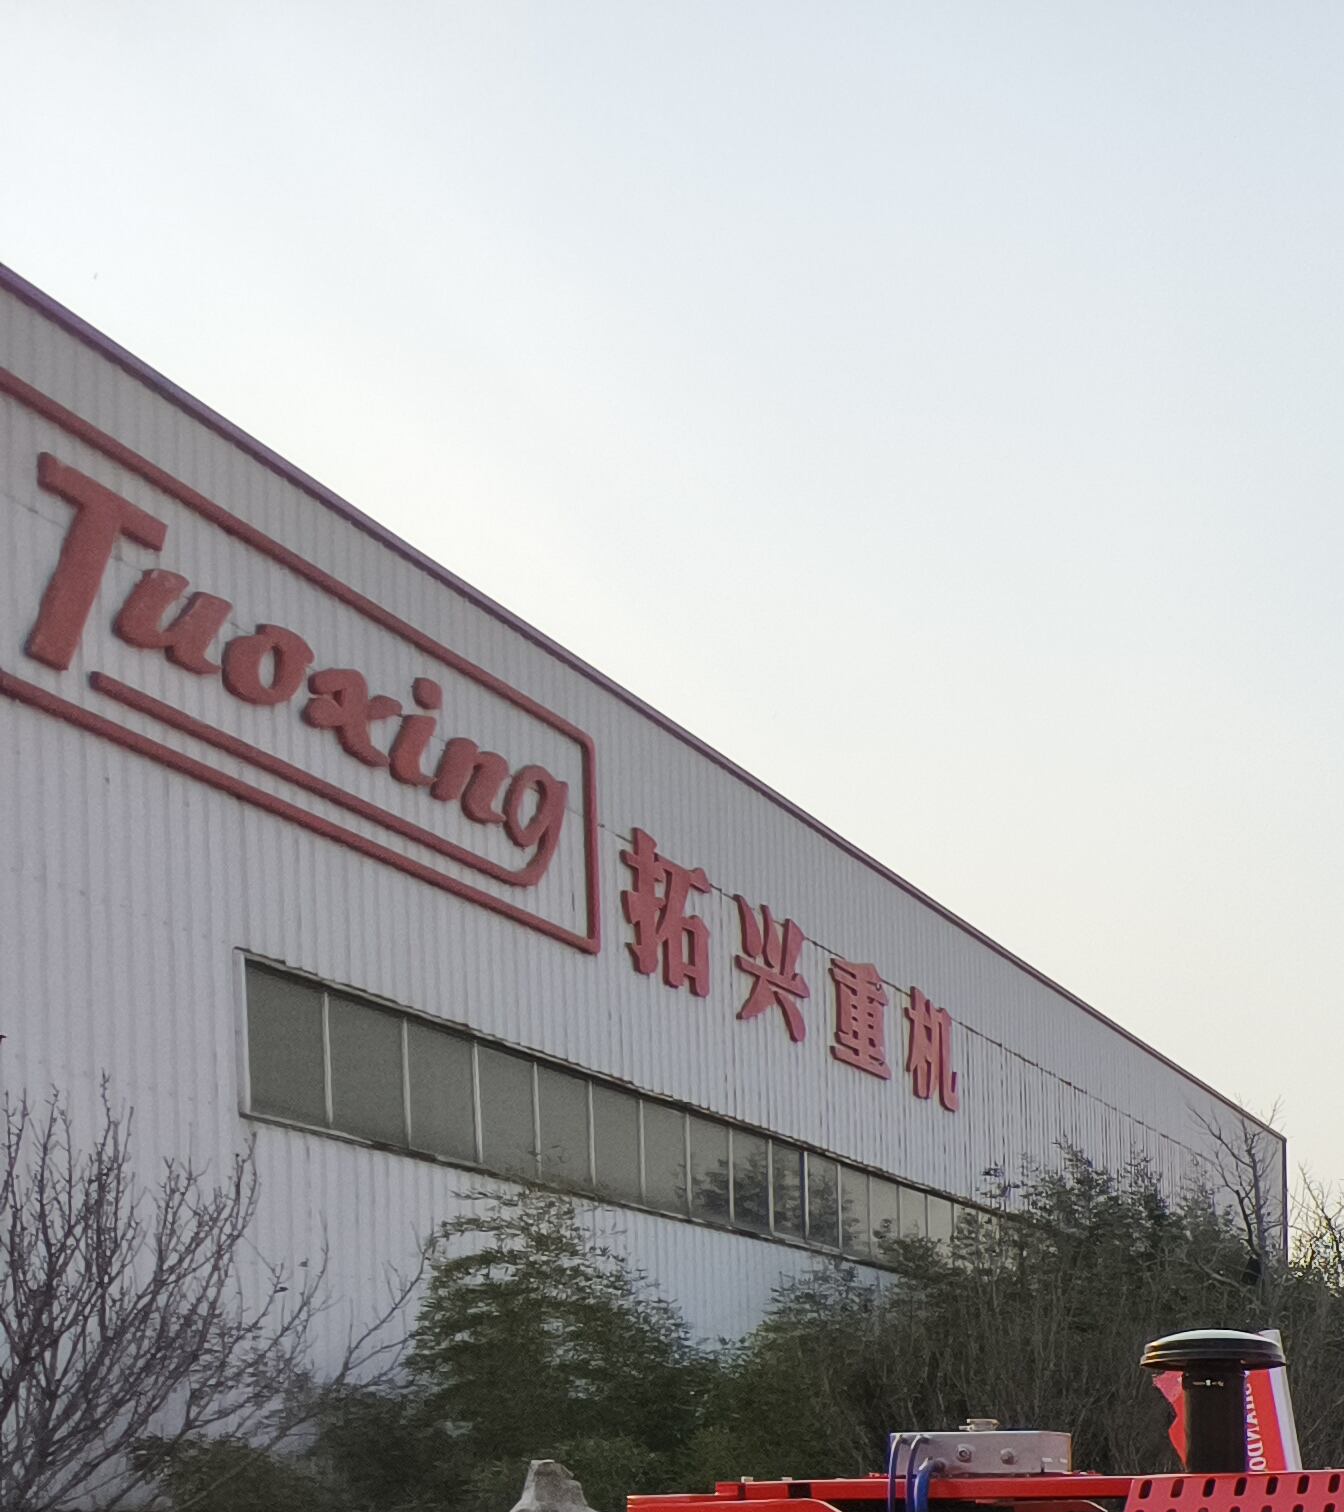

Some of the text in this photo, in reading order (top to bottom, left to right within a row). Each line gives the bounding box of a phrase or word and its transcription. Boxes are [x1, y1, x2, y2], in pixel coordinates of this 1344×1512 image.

[24, 451, 568, 887] Tuoxing
[619, 827, 960, 1112] 拓兴重机
